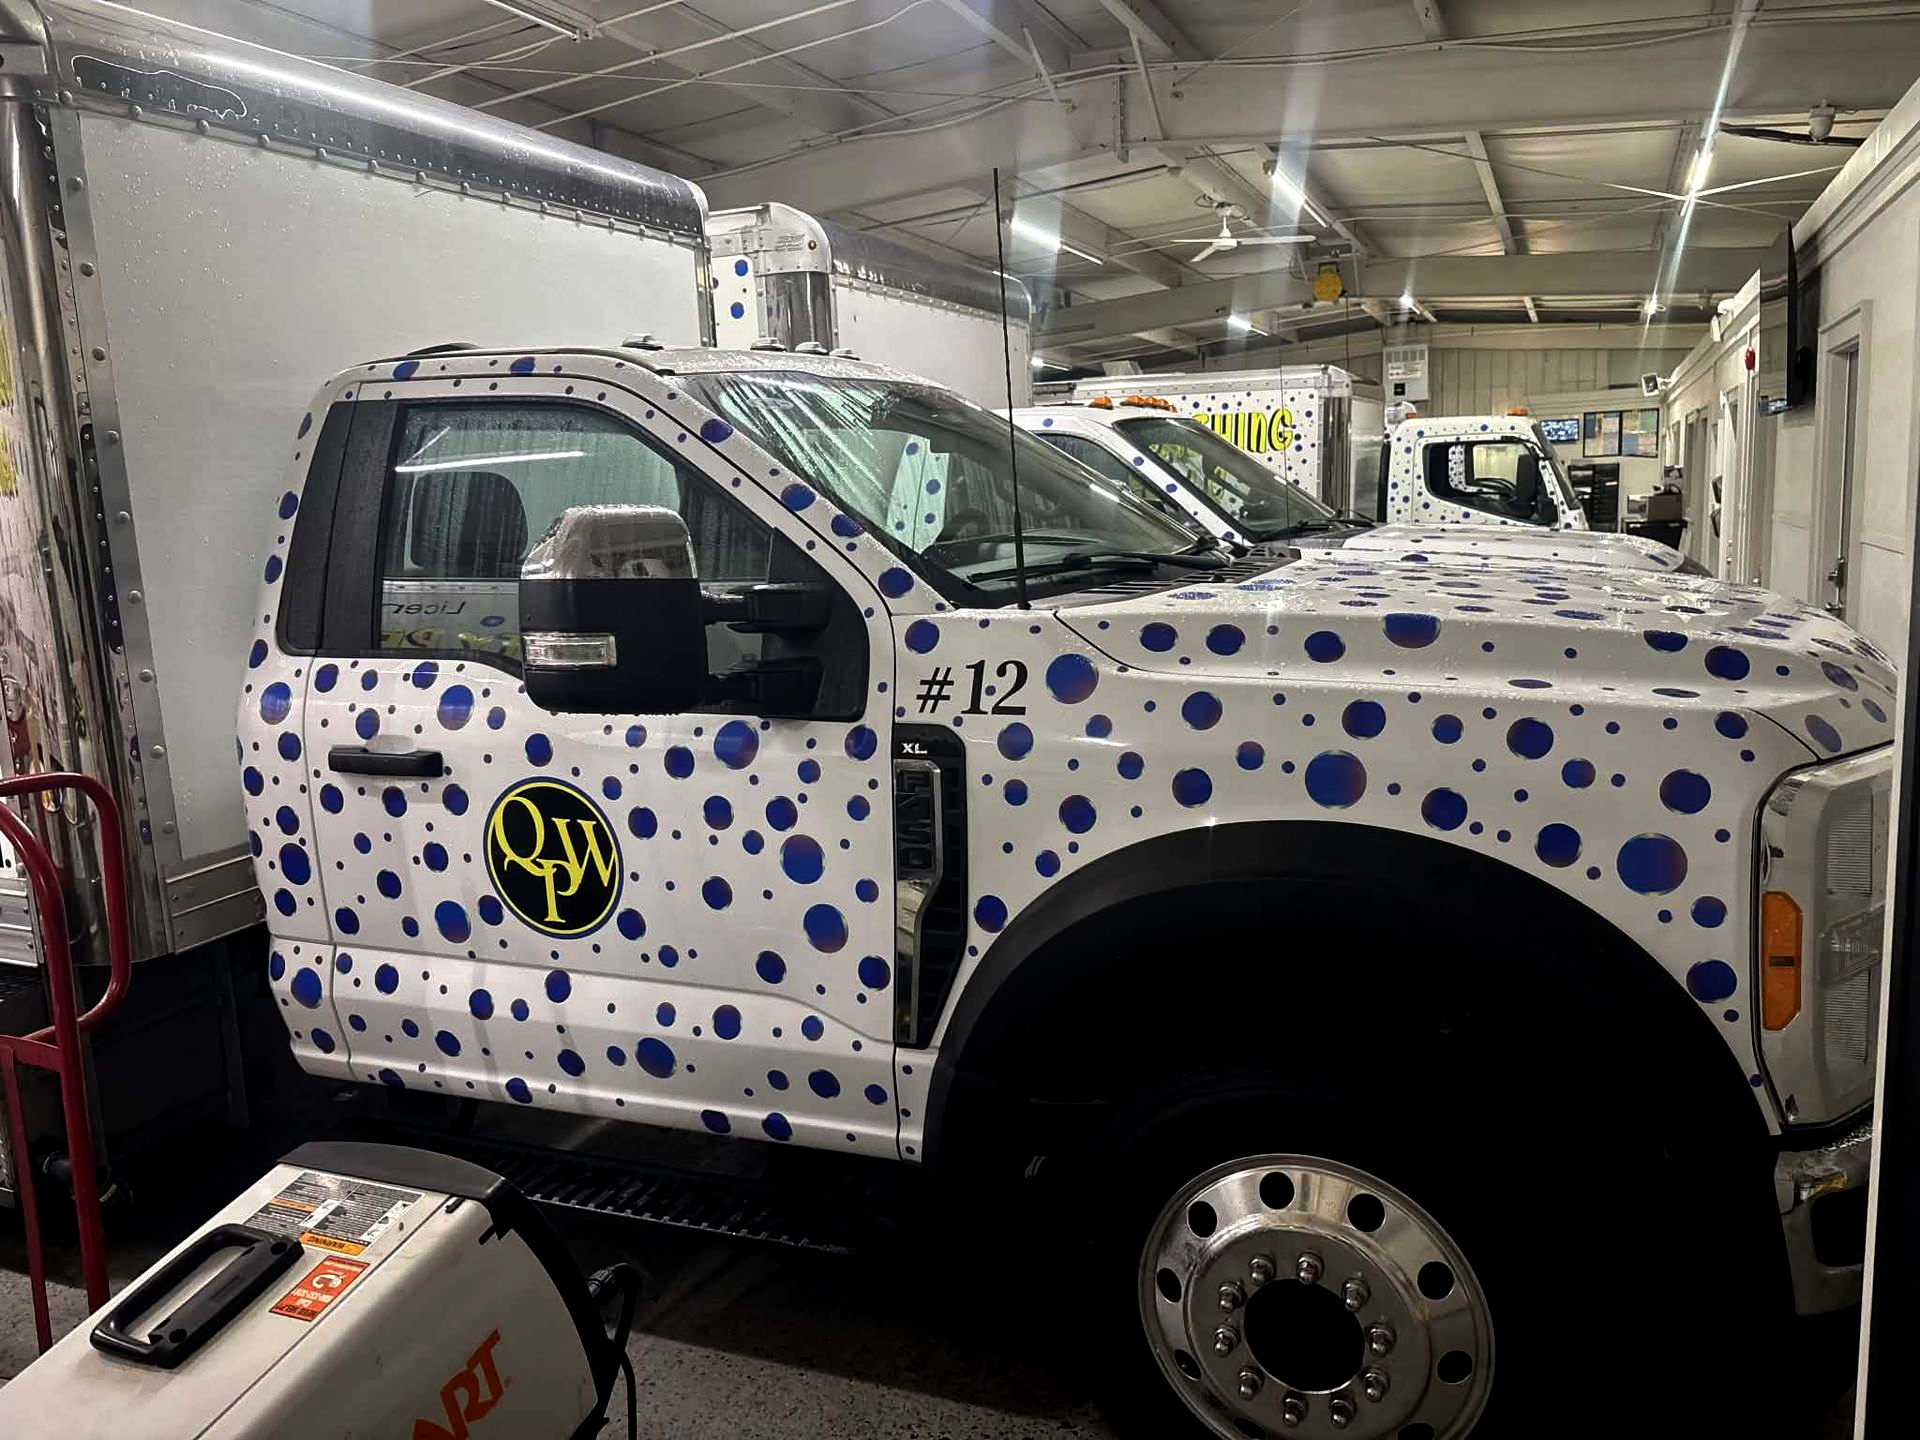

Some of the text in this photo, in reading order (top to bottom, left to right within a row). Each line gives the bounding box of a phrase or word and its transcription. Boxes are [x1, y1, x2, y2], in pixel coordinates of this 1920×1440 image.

[916, 660, 1028, 716] #12
[902, 743, 928, 754] XL
[494, 796, 616, 923] QPW
[307, 1235, 345, 1249] WARNING
